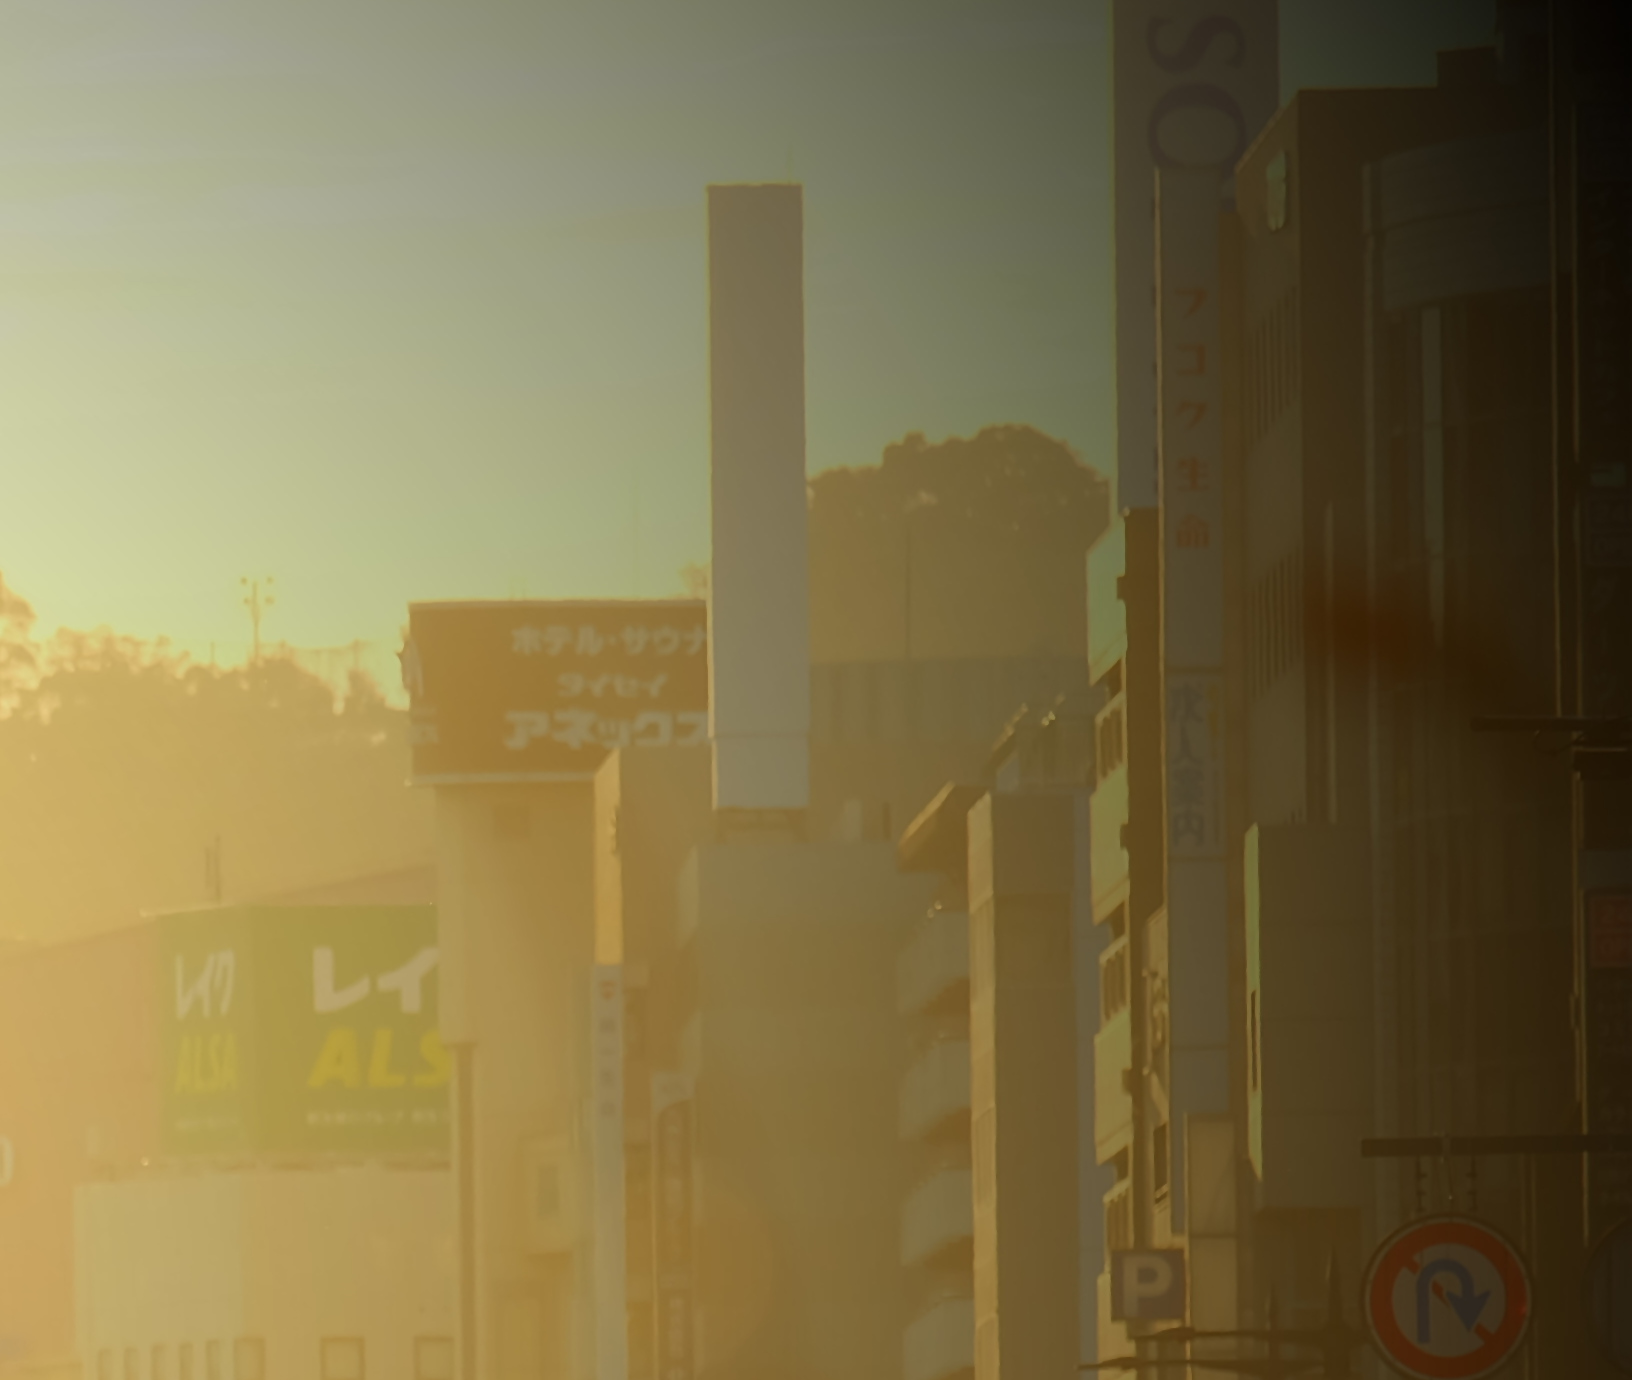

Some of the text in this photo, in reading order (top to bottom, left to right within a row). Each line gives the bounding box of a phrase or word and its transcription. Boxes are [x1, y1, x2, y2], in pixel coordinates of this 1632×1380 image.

[1173, 286, 1210, 550] フコク生命
[313, 945, 440, 1014] レイ
[174, 1031, 238, 1093] ALSA
[306, 1027, 454, 1089] ALS
[1122, 1254, 1173, 1317] P
